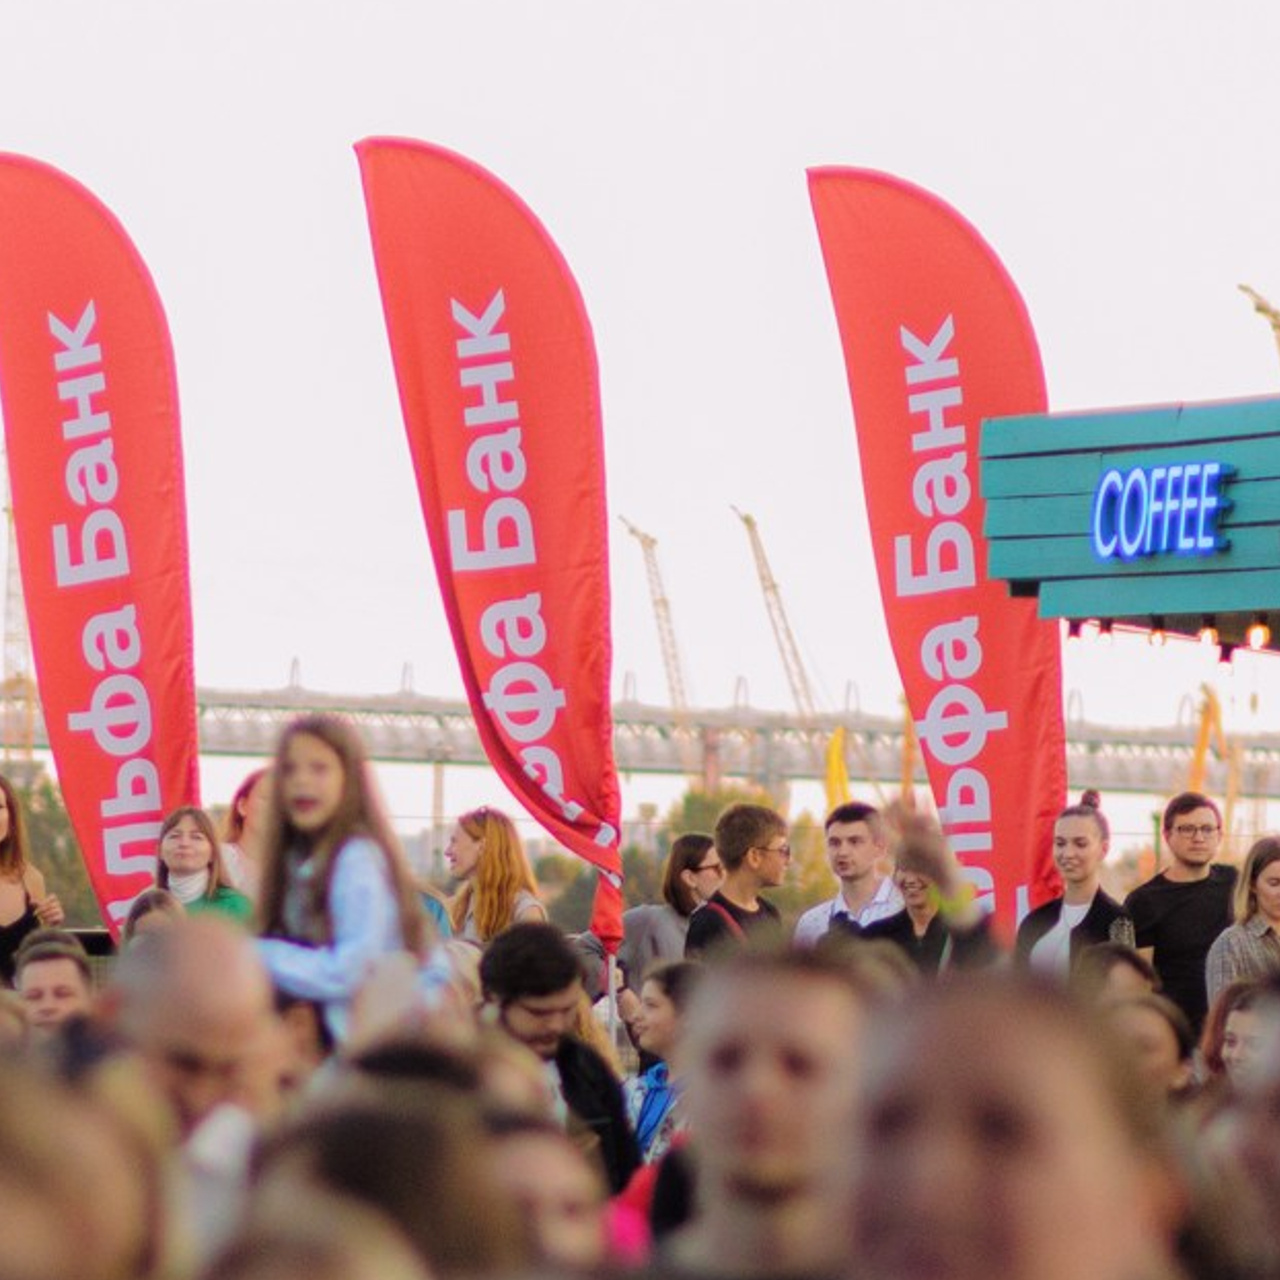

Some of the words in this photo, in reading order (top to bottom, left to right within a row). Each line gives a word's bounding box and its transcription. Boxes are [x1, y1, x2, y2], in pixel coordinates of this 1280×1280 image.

[48, 299, 131, 587] Банк
[447, 287, 537, 572] Банк
[894, 313, 976, 597] Банк
[1093, 462, 1221, 558] COFFEE
[915, 616, 1008, 913] льфа
